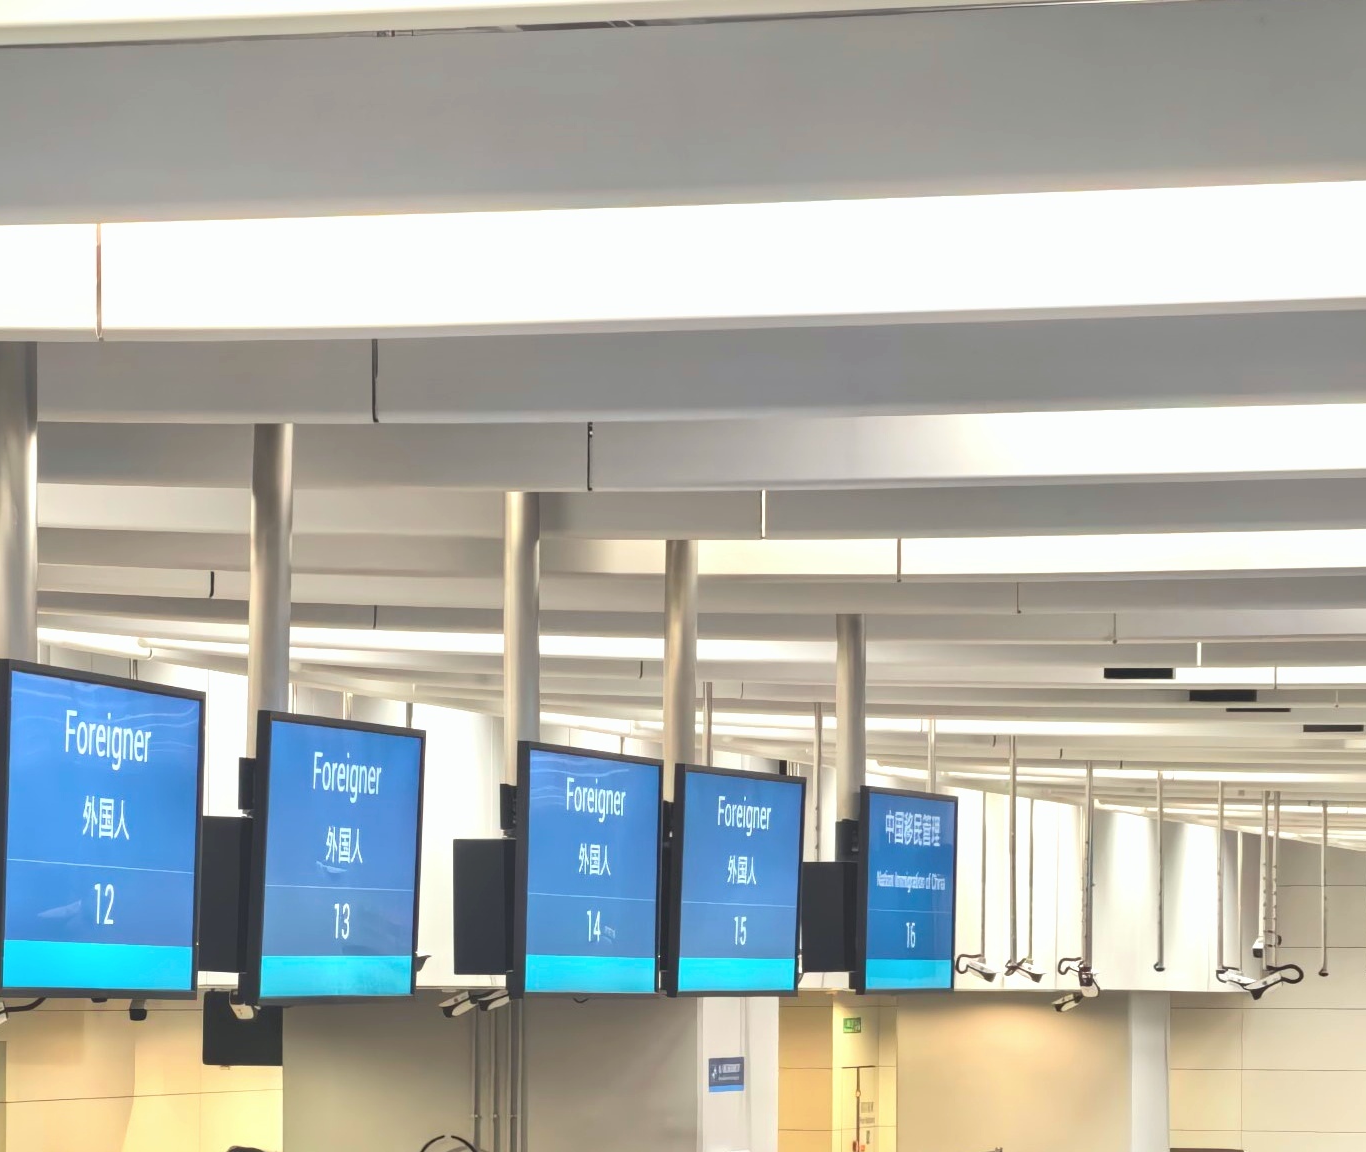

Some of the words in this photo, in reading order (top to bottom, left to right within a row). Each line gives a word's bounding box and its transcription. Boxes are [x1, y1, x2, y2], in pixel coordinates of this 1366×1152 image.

[64, 710, 152, 770] Foreigner
[312, 751, 382, 800] Foreigner
[565, 776, 626, 821] Foreigner
[716, 793, 772, 835] Foreigner
[81, 796, 130, 841] 外国人
[885, 810, 941, 847] 中国移民管理
[323, 825, 364, 865] 外国人
[577, 843, 612, 877] 外国人
[726, 854, 757, 887] 外国人
[93, 883, 115, 925] 12
[332, 903, 351, 940] 13
[585, 909, 602, 943] 14
[732, 914, 748, 947] 15
[905, 922, 916, 948] 16
